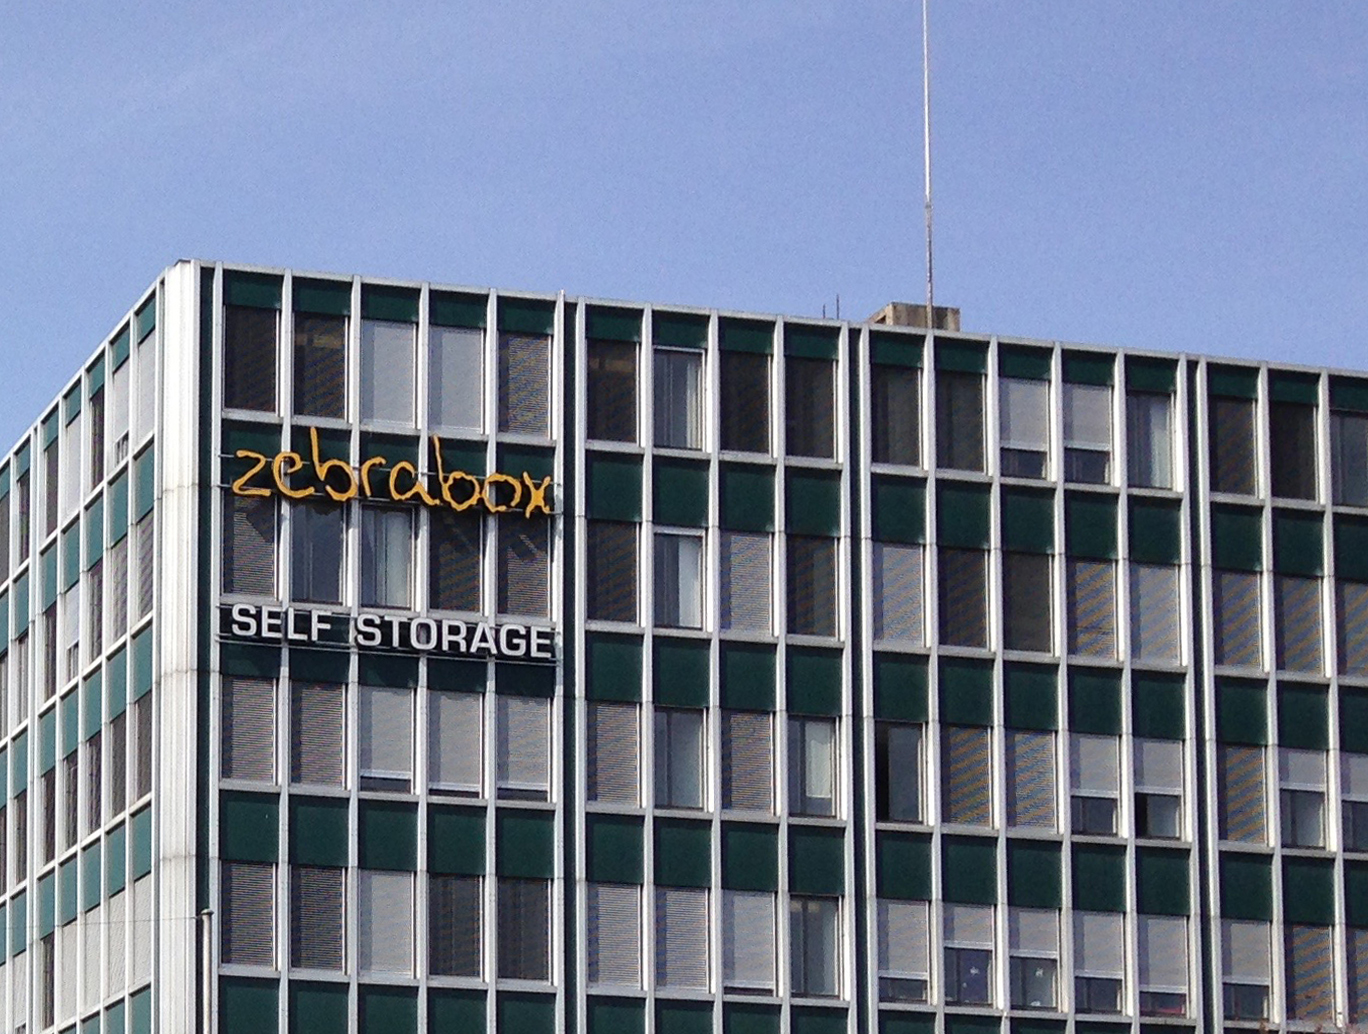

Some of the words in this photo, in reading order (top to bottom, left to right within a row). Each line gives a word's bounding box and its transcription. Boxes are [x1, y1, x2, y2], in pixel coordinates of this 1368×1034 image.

[232, 426, 551, 519] zebrabox
[231, 603, 332, 642] SELF
[355, 613, 553, 658] STORAGE
